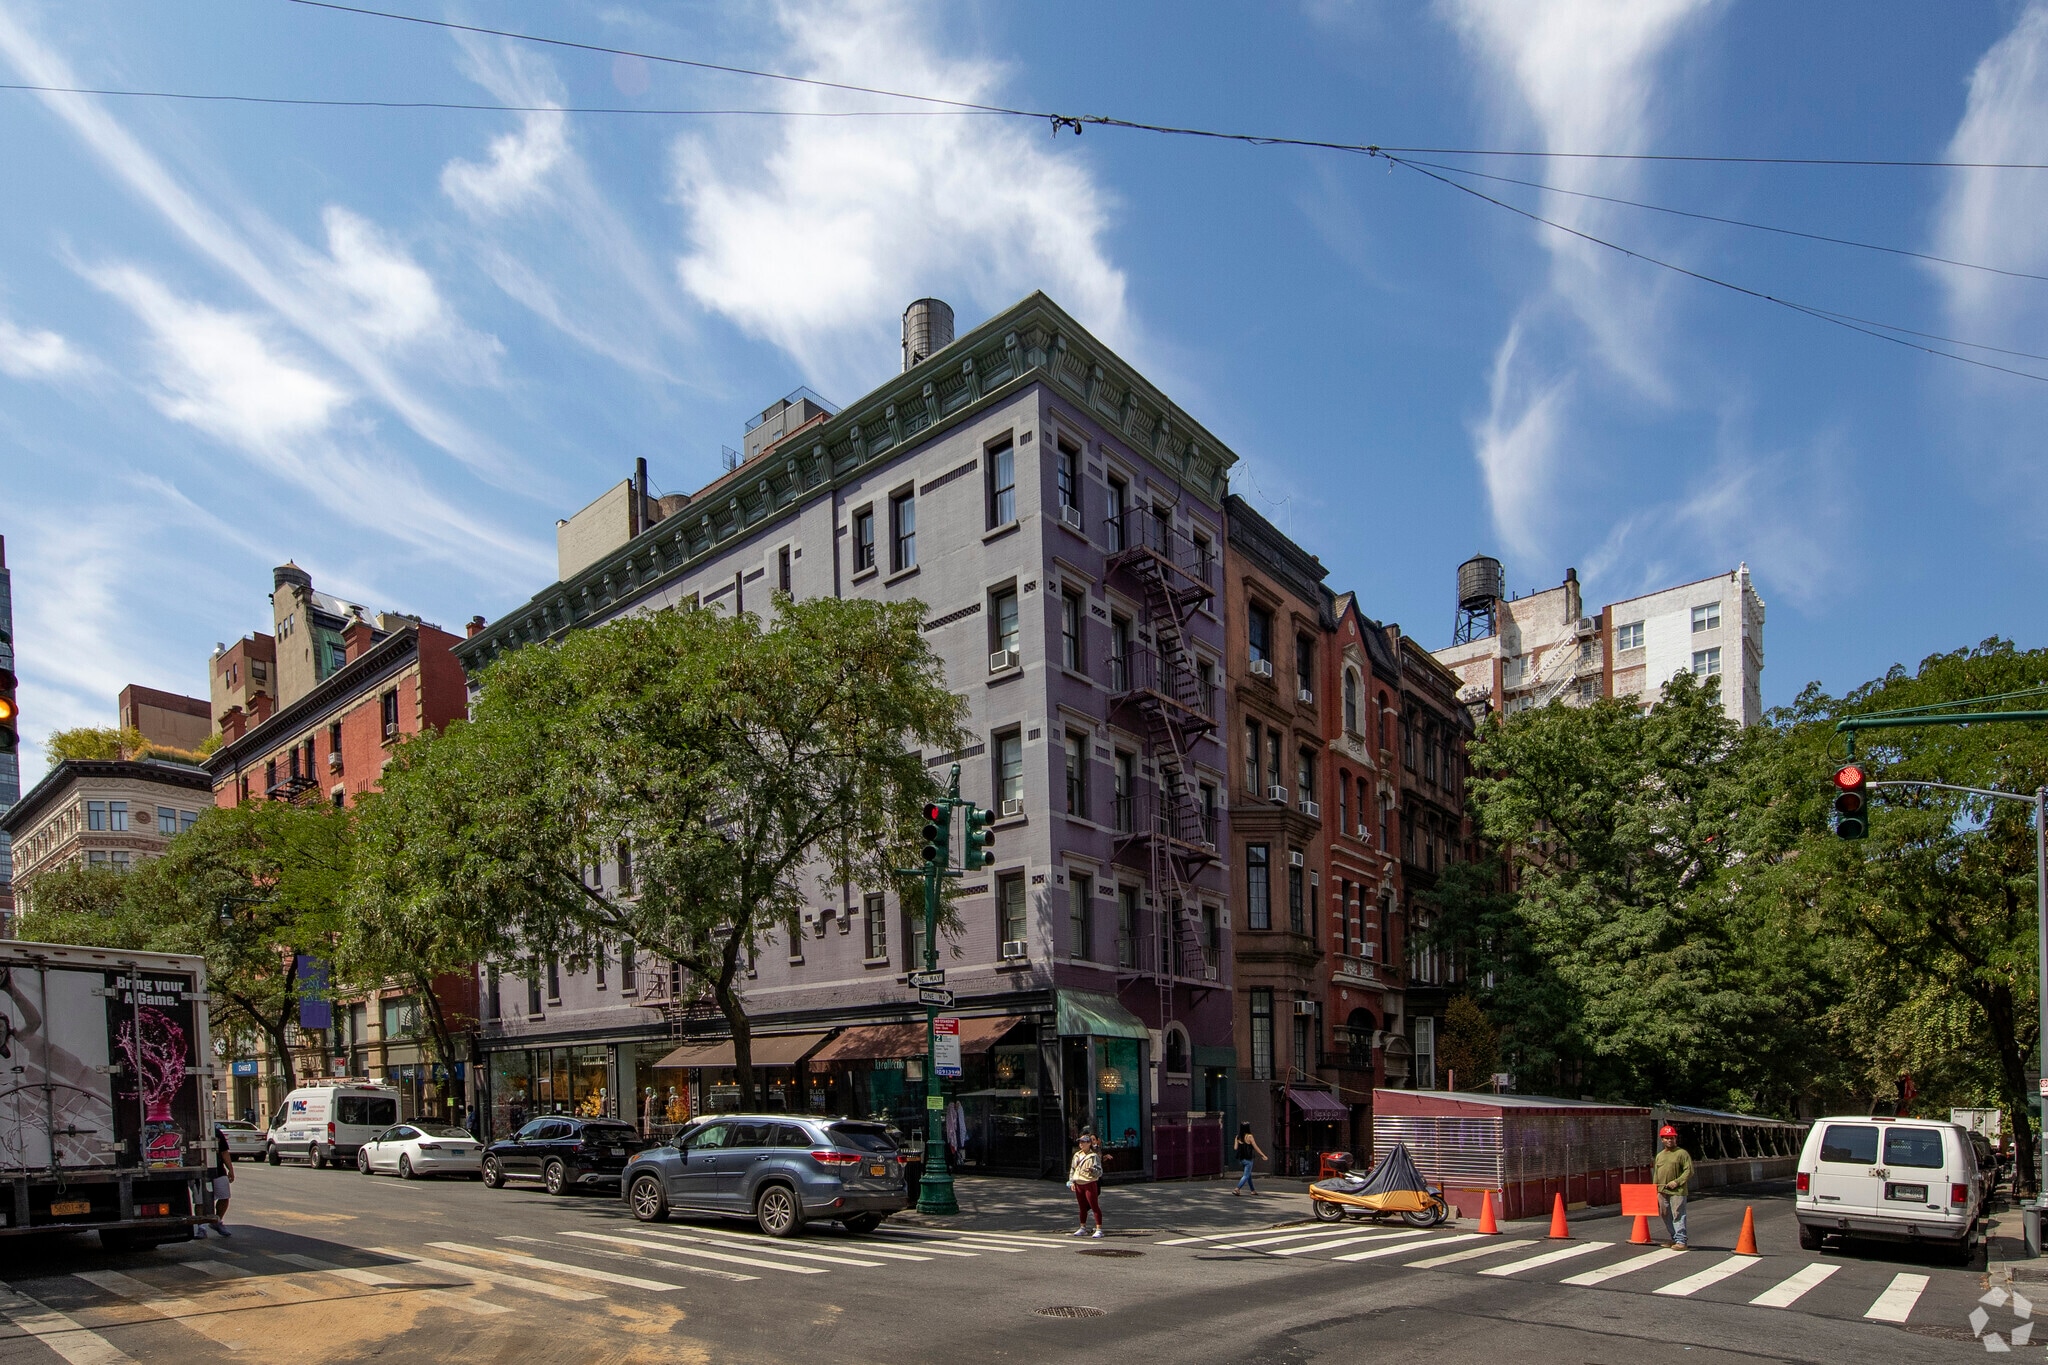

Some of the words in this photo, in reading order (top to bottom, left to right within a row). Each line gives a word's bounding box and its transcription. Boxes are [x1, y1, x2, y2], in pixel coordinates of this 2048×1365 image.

[914, 976, 924, 984] ONE
[929, 974, 940, 983] WAY
[117, 976, 152, 992] Brng
[154, 980, 184, 993] your
[138, 992, 179, 1006] Game.
[924, 992, 934, 1000] ONE
[292, 1100, 307, 1111] MAC
[147, 1150, 180, 1159] -GAME
